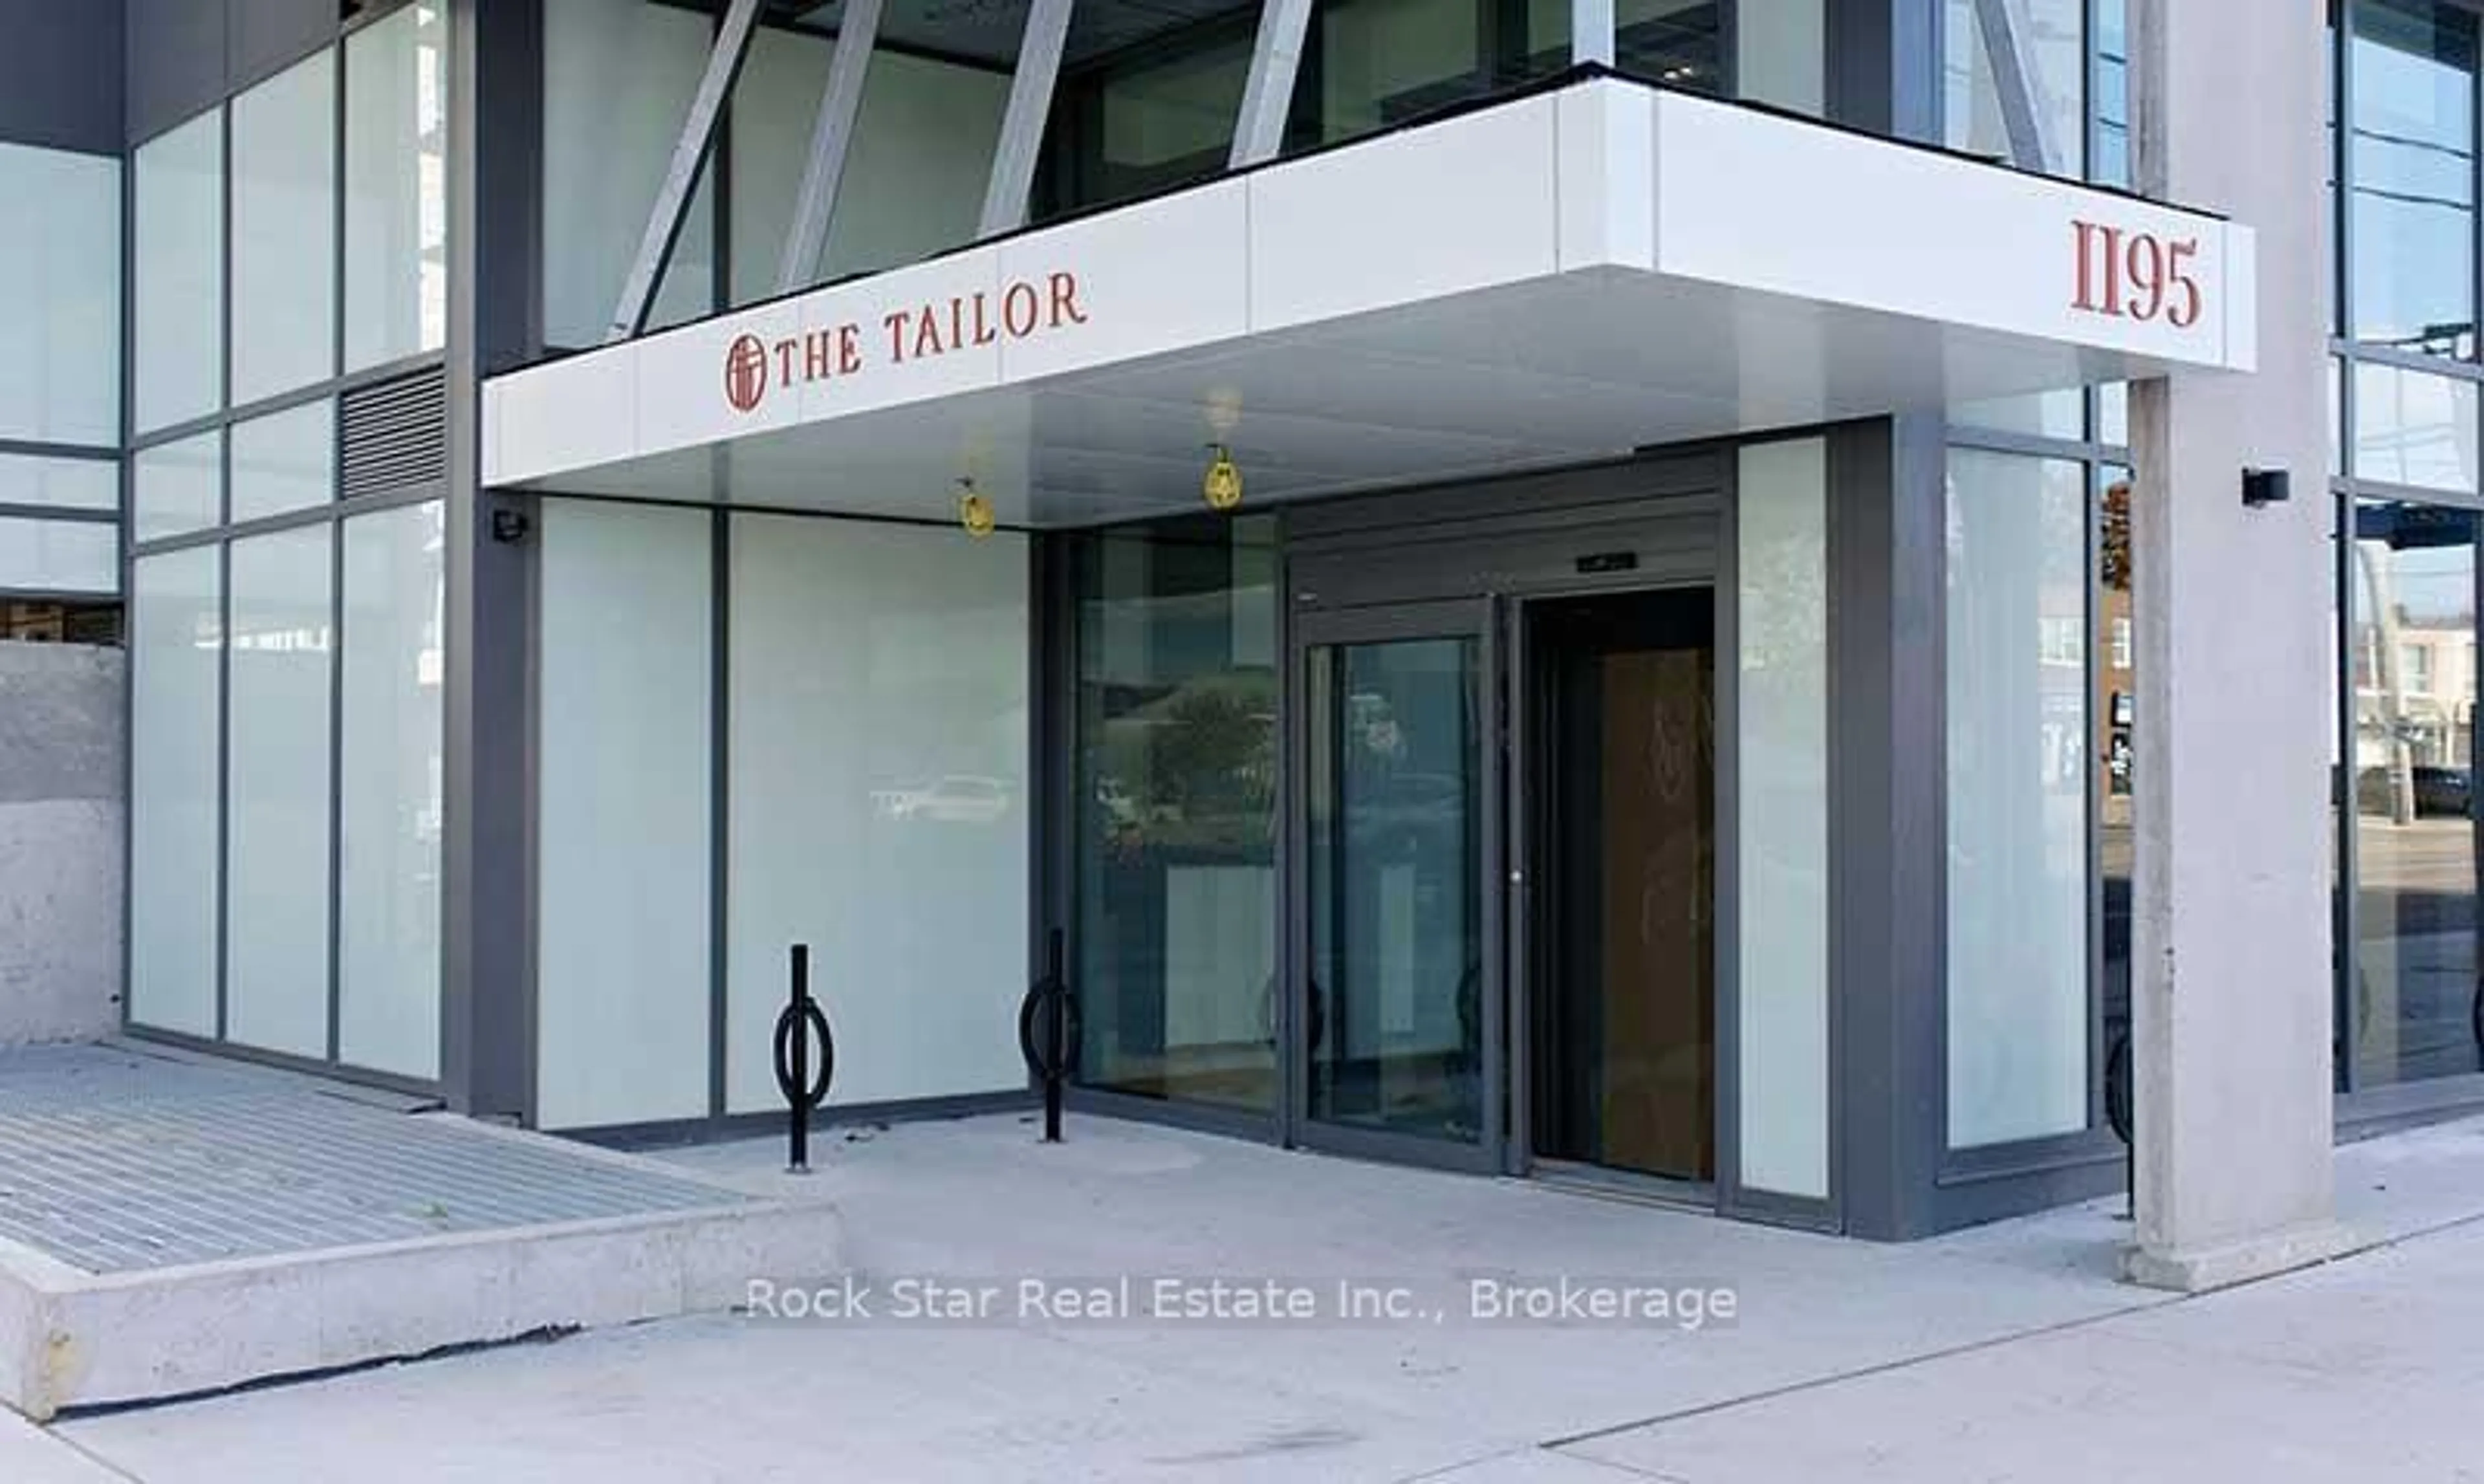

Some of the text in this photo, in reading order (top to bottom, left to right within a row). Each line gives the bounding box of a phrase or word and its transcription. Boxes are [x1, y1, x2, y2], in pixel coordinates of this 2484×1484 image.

[2070, 220, 2202, 327] 1195
[774, 272, 1087, 388] THE TAILOR
